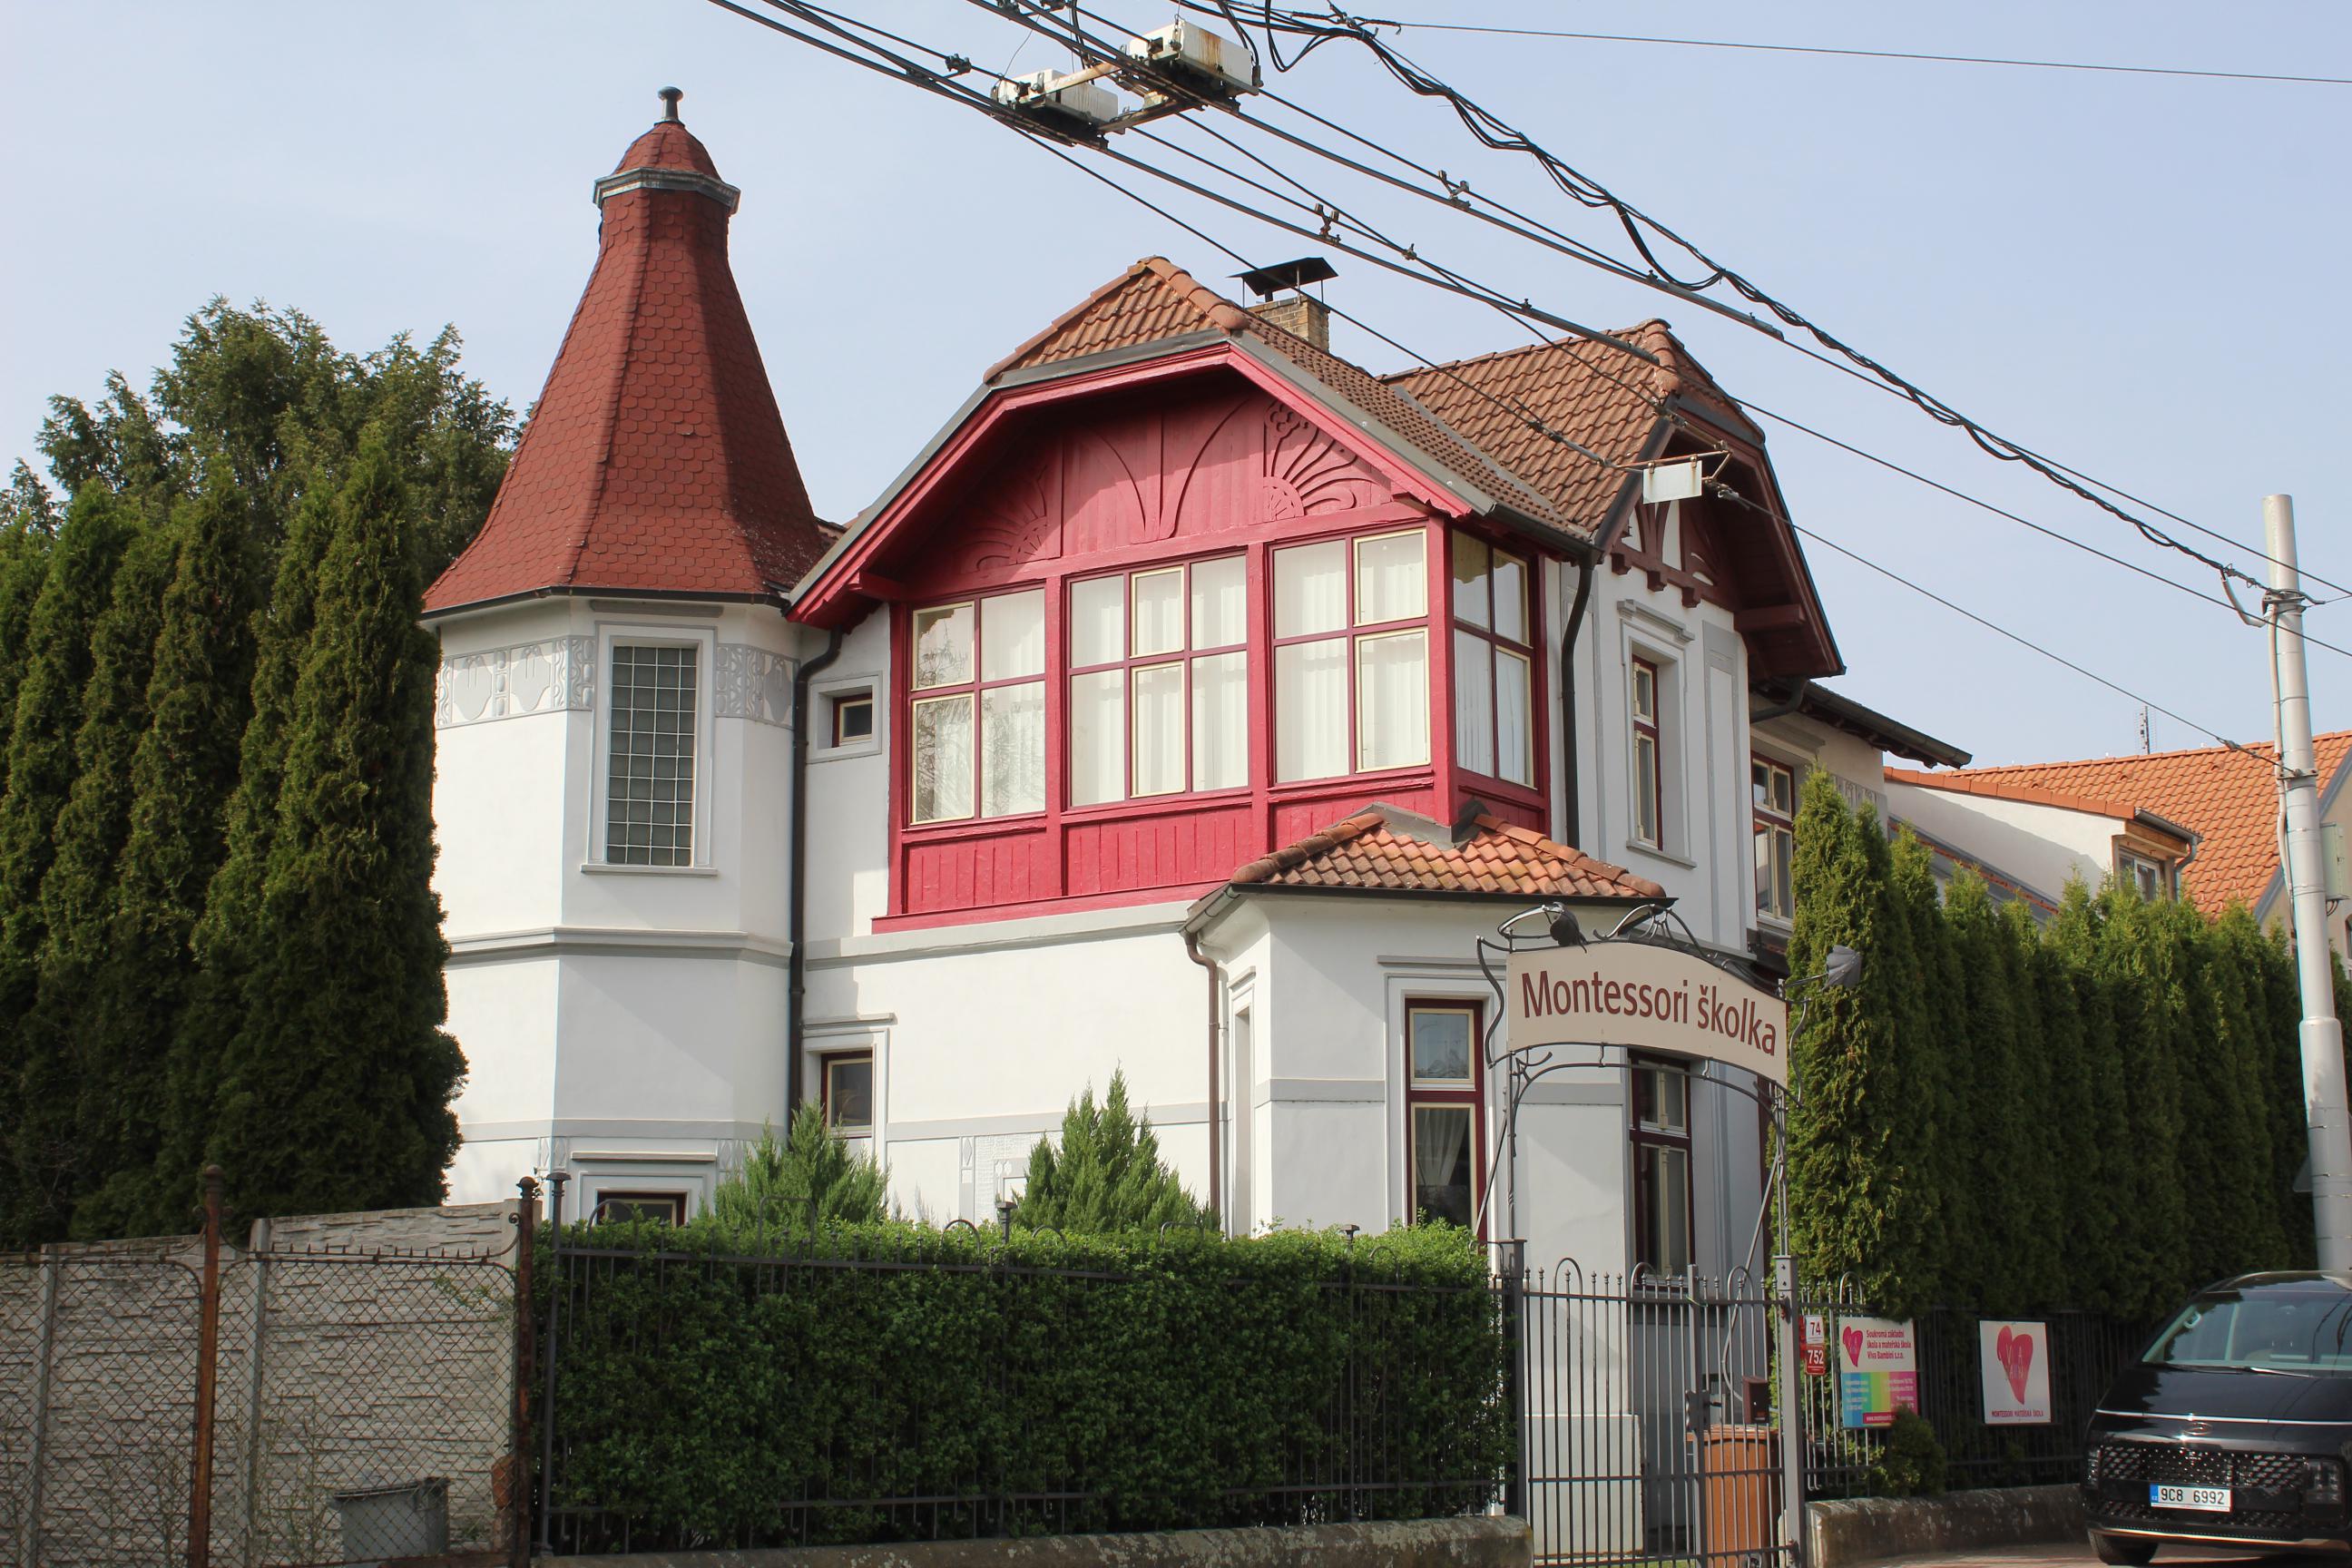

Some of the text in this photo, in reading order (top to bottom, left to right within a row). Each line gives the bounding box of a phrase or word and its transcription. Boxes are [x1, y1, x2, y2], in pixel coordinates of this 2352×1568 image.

[1521, 970, 1777, 1056] Montessori školka
[1809, 1321, 1821, 1336] 74
[1808, 1349, 1824, 1364] 752
[2161, 1487, 2224, 1504] 9C8 6992
